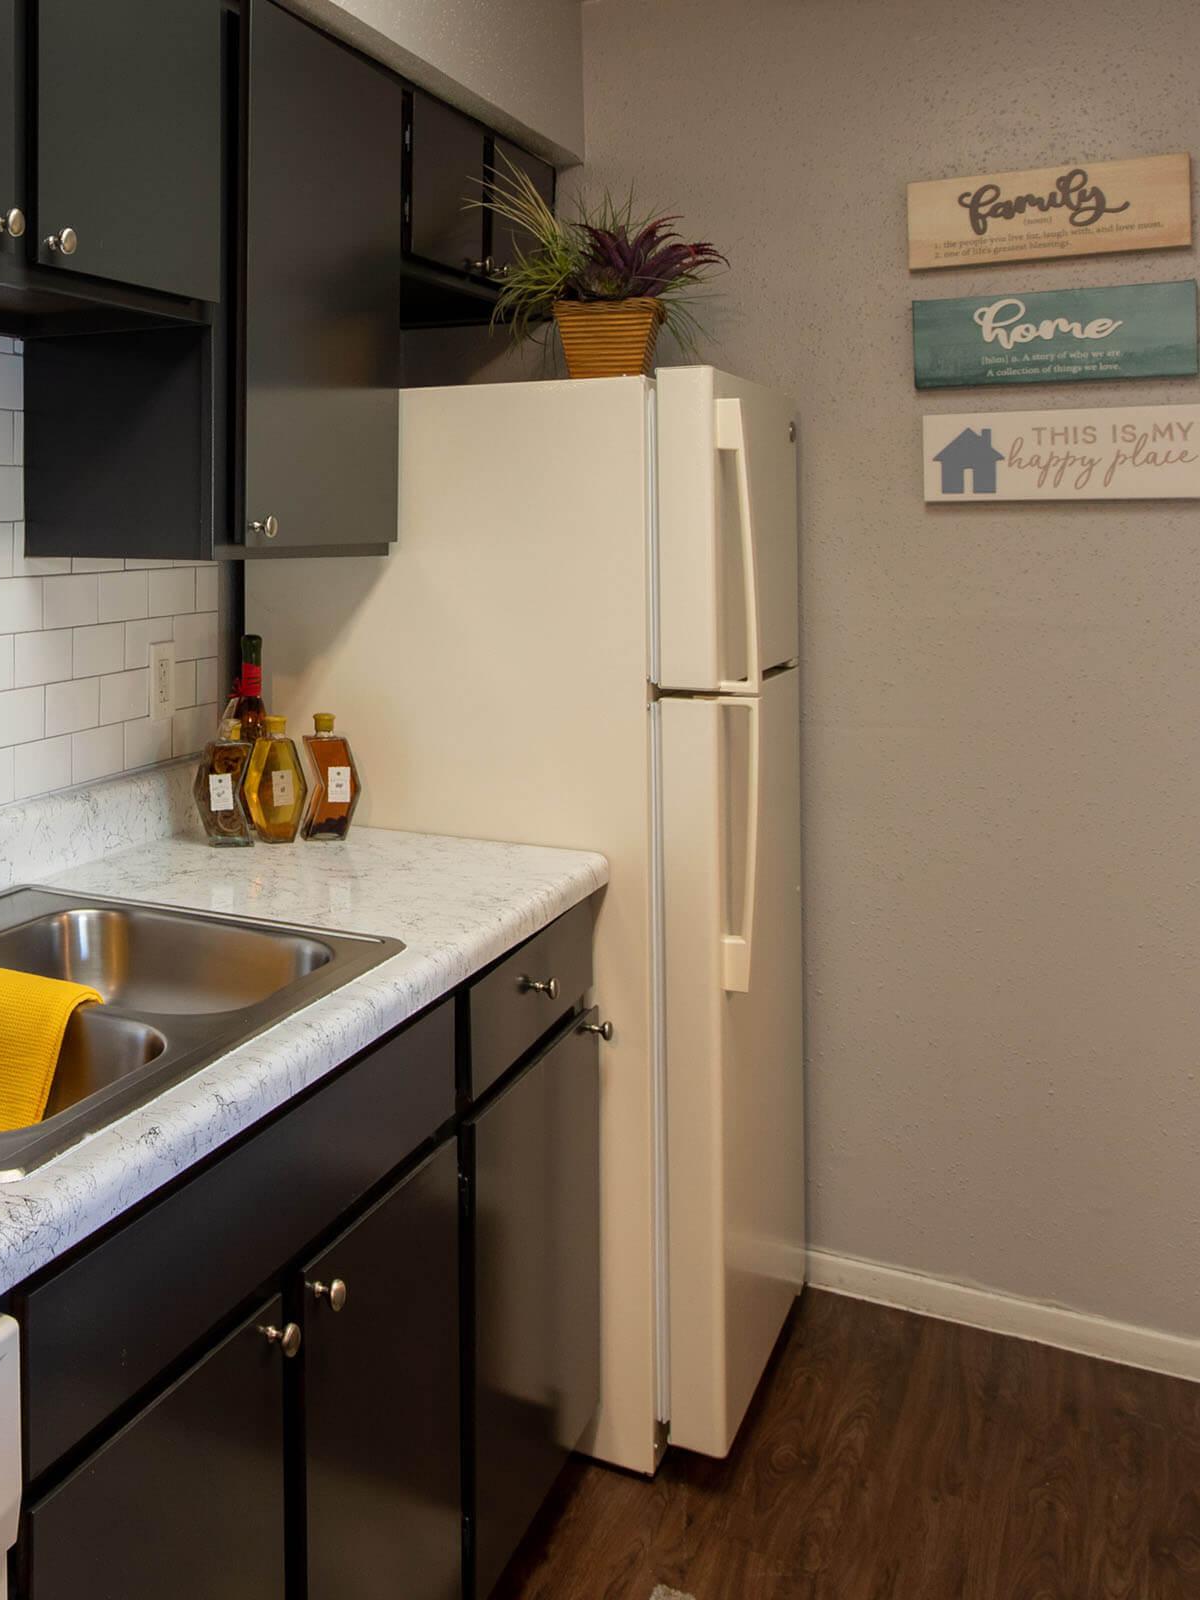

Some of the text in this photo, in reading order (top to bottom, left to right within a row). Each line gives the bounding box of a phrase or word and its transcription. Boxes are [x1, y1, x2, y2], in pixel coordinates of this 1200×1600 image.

[958, 168, 1130, 236] family
[943, 240, 957, 249] the
[959, 237, 987, 250] people
[1007, 233, 1024, 241] live
[1042, 228, 1068, 239] laugh
[1096, 224, 1113, 233] and
[1115, 223, 1136, 232] love
[960, 247, 970, 257] of
[973, 298, 1123, 349] home
[1022, 353, 1030, 361] A
[1031, 352, 1056, 362] story
[1057, 350, 1067, 360] of
[1069, 349, 1089, 359] who
[1090, 351, 1104, 359] we
[986, 361, 1121, 377] A collection of things we love.
[1031, 421, 1194, 446] THIS IS MY
[1007, 432, 1199, 490] happy place
